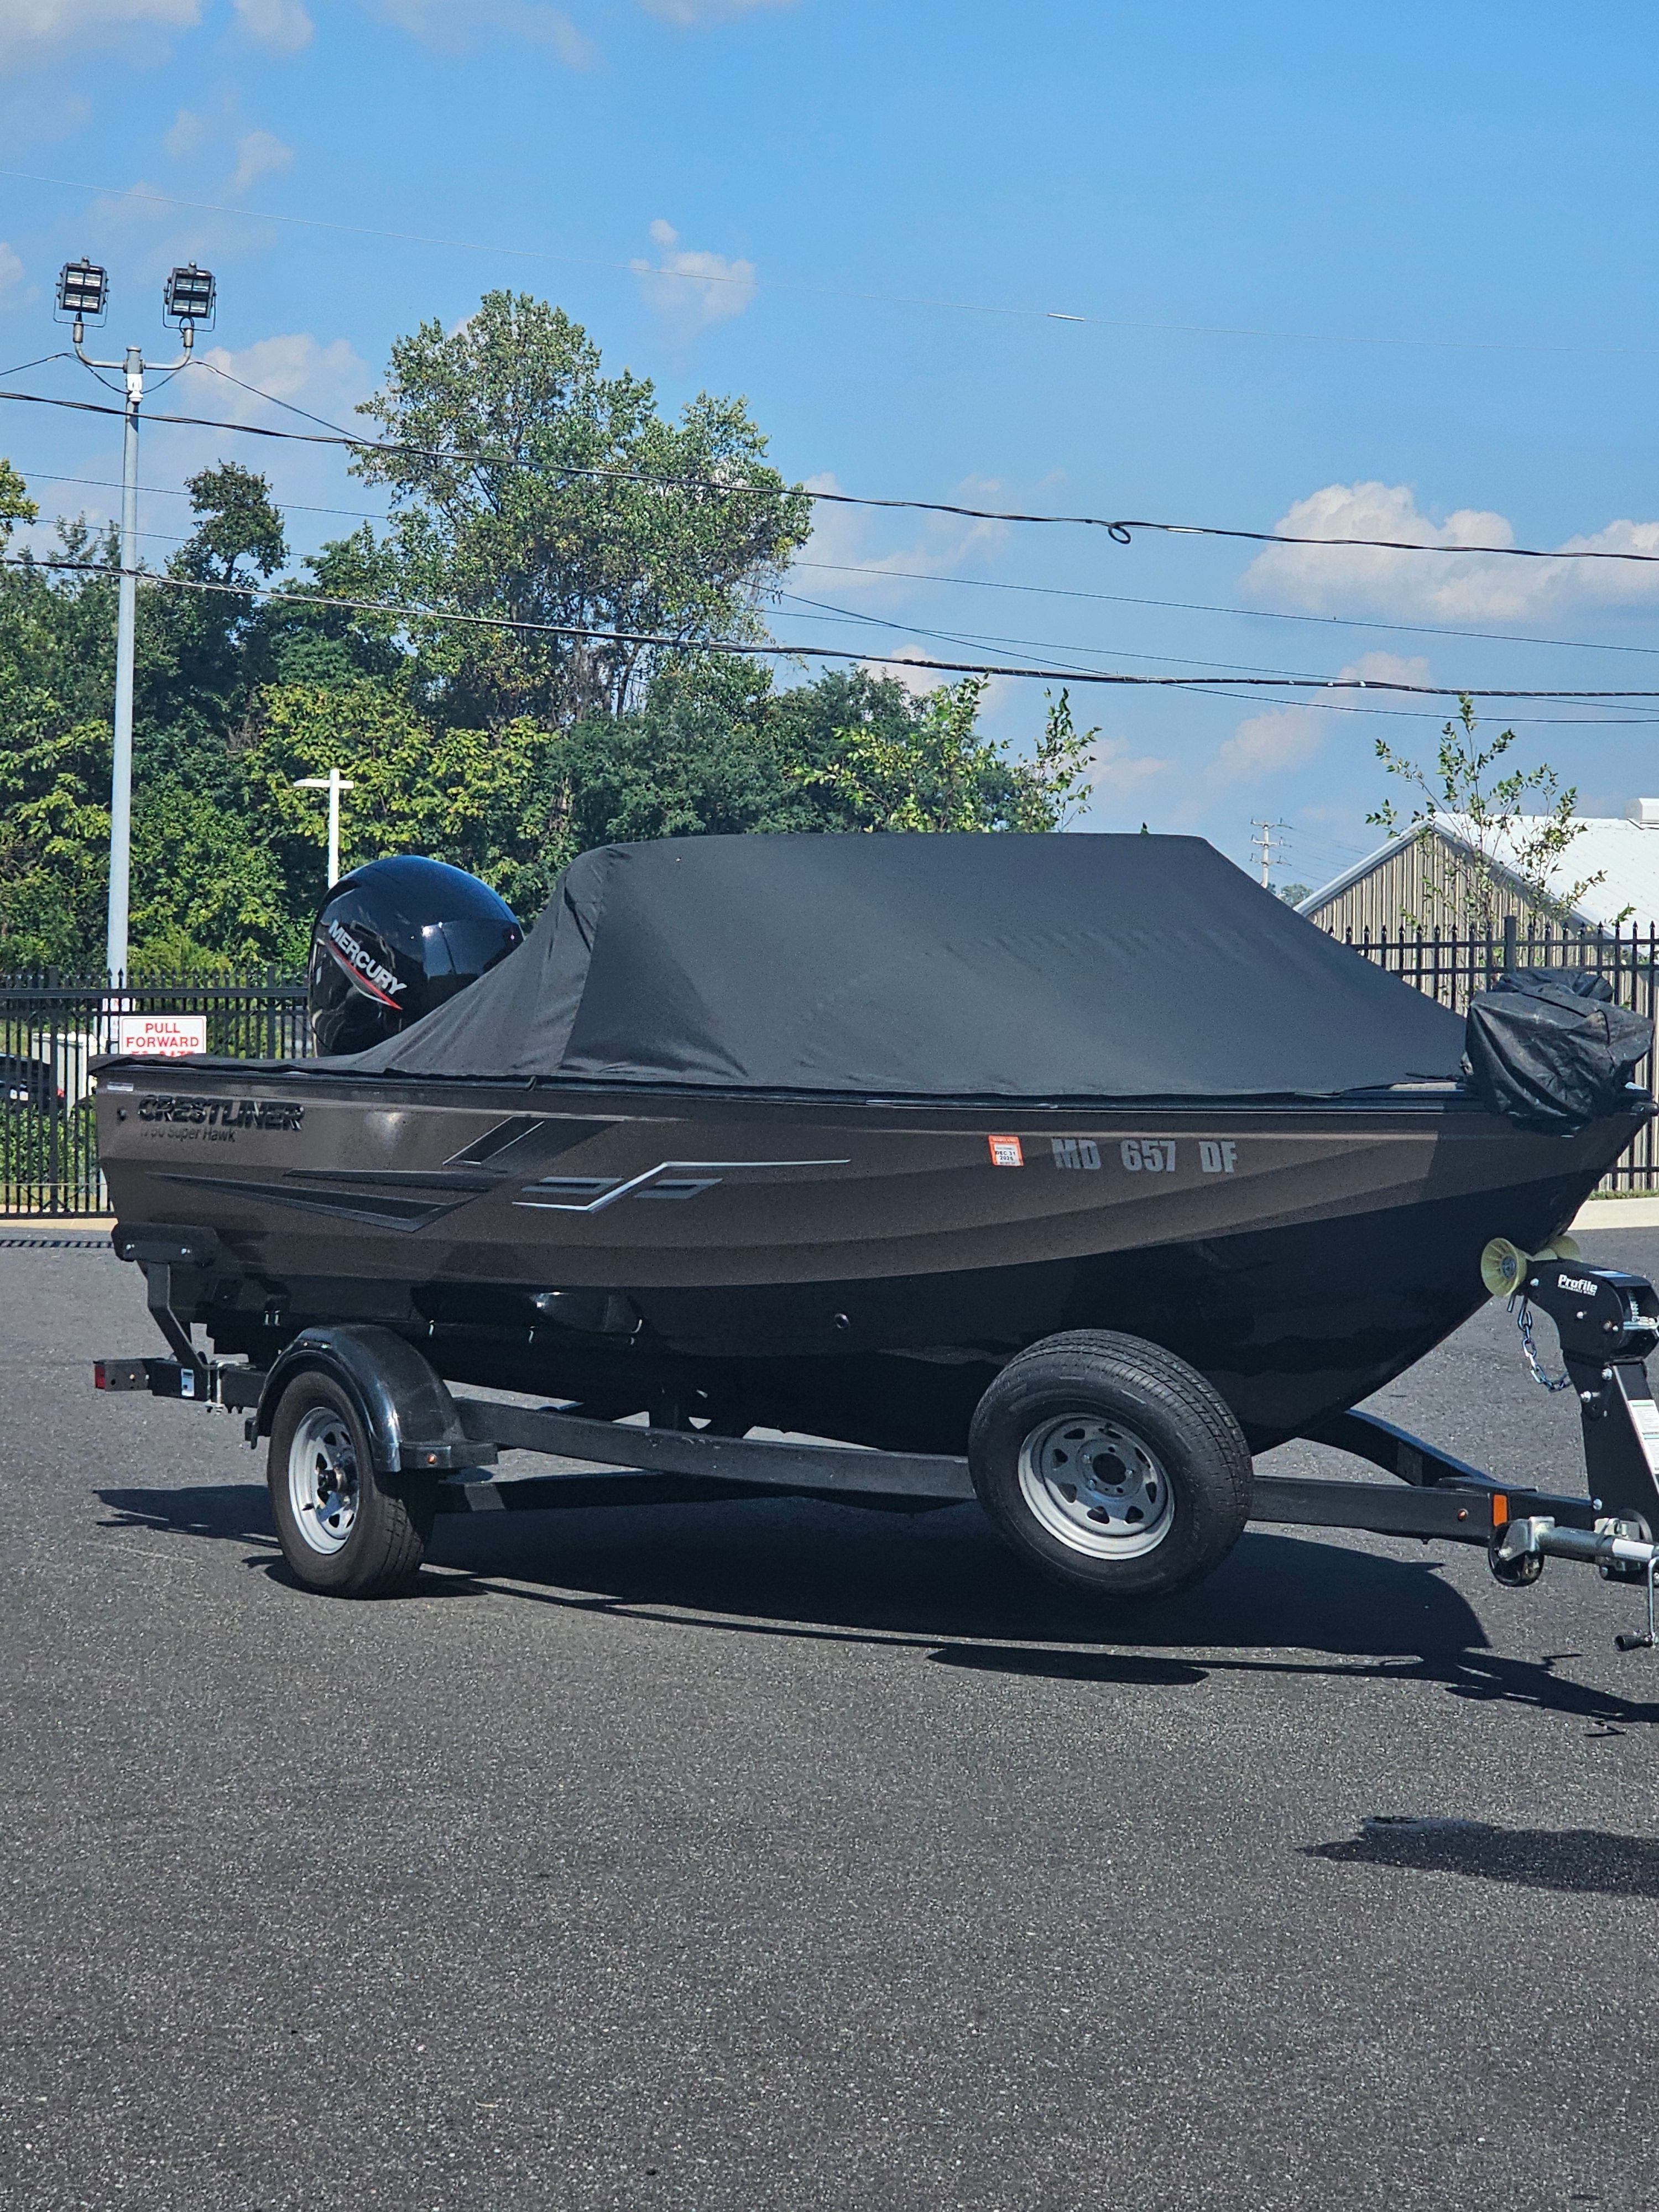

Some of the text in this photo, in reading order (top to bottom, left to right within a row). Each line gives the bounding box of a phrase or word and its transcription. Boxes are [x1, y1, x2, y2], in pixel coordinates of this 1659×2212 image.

[328, 919, 408, 995] MERCURY
[145, 1022, 181, 1034] PULL
[126, 1036, 200, 1047] FORWARD
[138, 1094, 304, 1131] CRESTLINER
[167, 1125, 200, 1142] Super
[202, 1126, 236, 1142] Hawk
[1051, 1138, 1238, 1173] MD 657 DF
[1558, 1274, 1598, 1292] Profile
